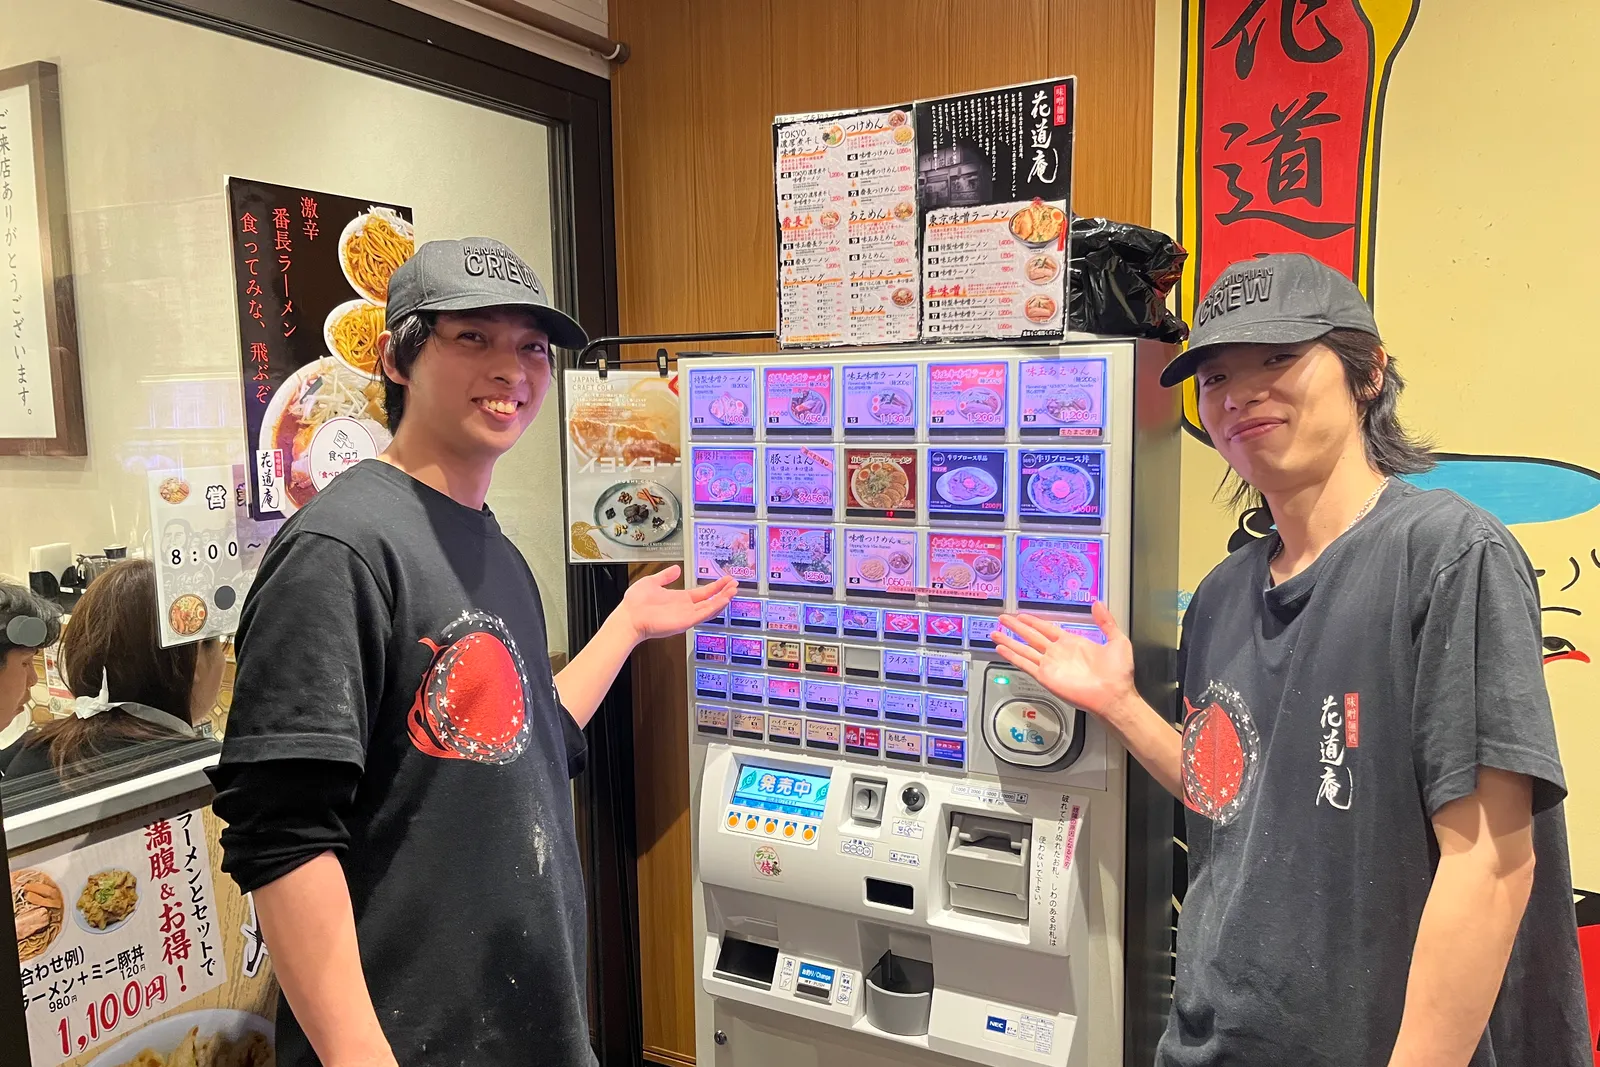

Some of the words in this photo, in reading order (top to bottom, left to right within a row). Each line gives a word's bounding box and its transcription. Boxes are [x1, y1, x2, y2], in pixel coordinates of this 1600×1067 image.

[846, 118, 884, 132] つけめん
[1212, 0, 1355, 257] 花道
[780, 129, 807, 139] TOKYO
[1027, 90, 1058, 183] 花道庵
[780, 145, 829, 157] 味噌ラーメン
[300, 196, 320, 241] 激辛
[849, 208, 886, 221] あえめん
[928, 209, 1009, 227] 東京味噌ラーメン
[940, 241, 988, 251] 特製味噌ラーメン
[940, 254, 988, 264] 味玉味噌ラーメン
[271, 207, 298, 338] 番長ラーメン
[464, 253, 540, 294] CREW
[850, 269, 913, 280] サイドメニュー
[940, 268, 976, 277] 味噌ラーメン
[784, 273, 825, 285] トッピング
[926, 285, 961, 298] 辛味噌
[941, 297, 995, 307] 特製辛味噌ラーメン
[1199, 275, 1273, 327] CREW
[851, 305, 885, 315] ドリンク
[940, 310, 995, 319] 味玉辛味噌ラーメン
[941, 324, 983, 333] 辛味噌ラーメン
[846, 371, 912, 379] 味玉味噌ラーメン
[1026, 365, 1089, 377] 味玉あえめん
[694, 374, 750, 384] 特製味噌ラーメン
[967, 412, 1001, 423] 1,200円
[1060, 411, 1098, 421] 1,200円
[328, 450, 359, 461] 食べログ
[770, 453, 814, 466] 豚ごはん
[260, 451, 280, 509] 花道庵
[318, 470, 346, 480] 「食べロ
[848, 534, 896, 544] 味噌つけめん
[882, 577, 912, 587] 1,050円
[968, 582, 1000, 592] 1,100円
[888, 656, 908, 664] ライス
[1316, 695, 1353, 810] 花道庵
[758, 773, 812, 799] 発売中
[1033, 836, 1047, 906] 使わないで下さい。
[176, 808, 218, 978] ラーメンとセットで
[143, 818, 194, 993] 満腹&お得!
[120, 962, 146, 981] 120円
[49, 993, 78, 1013] 980円
[57, 974, 168, 1057] 1,100円
[989, 1020, 1004, 1029] NEC
